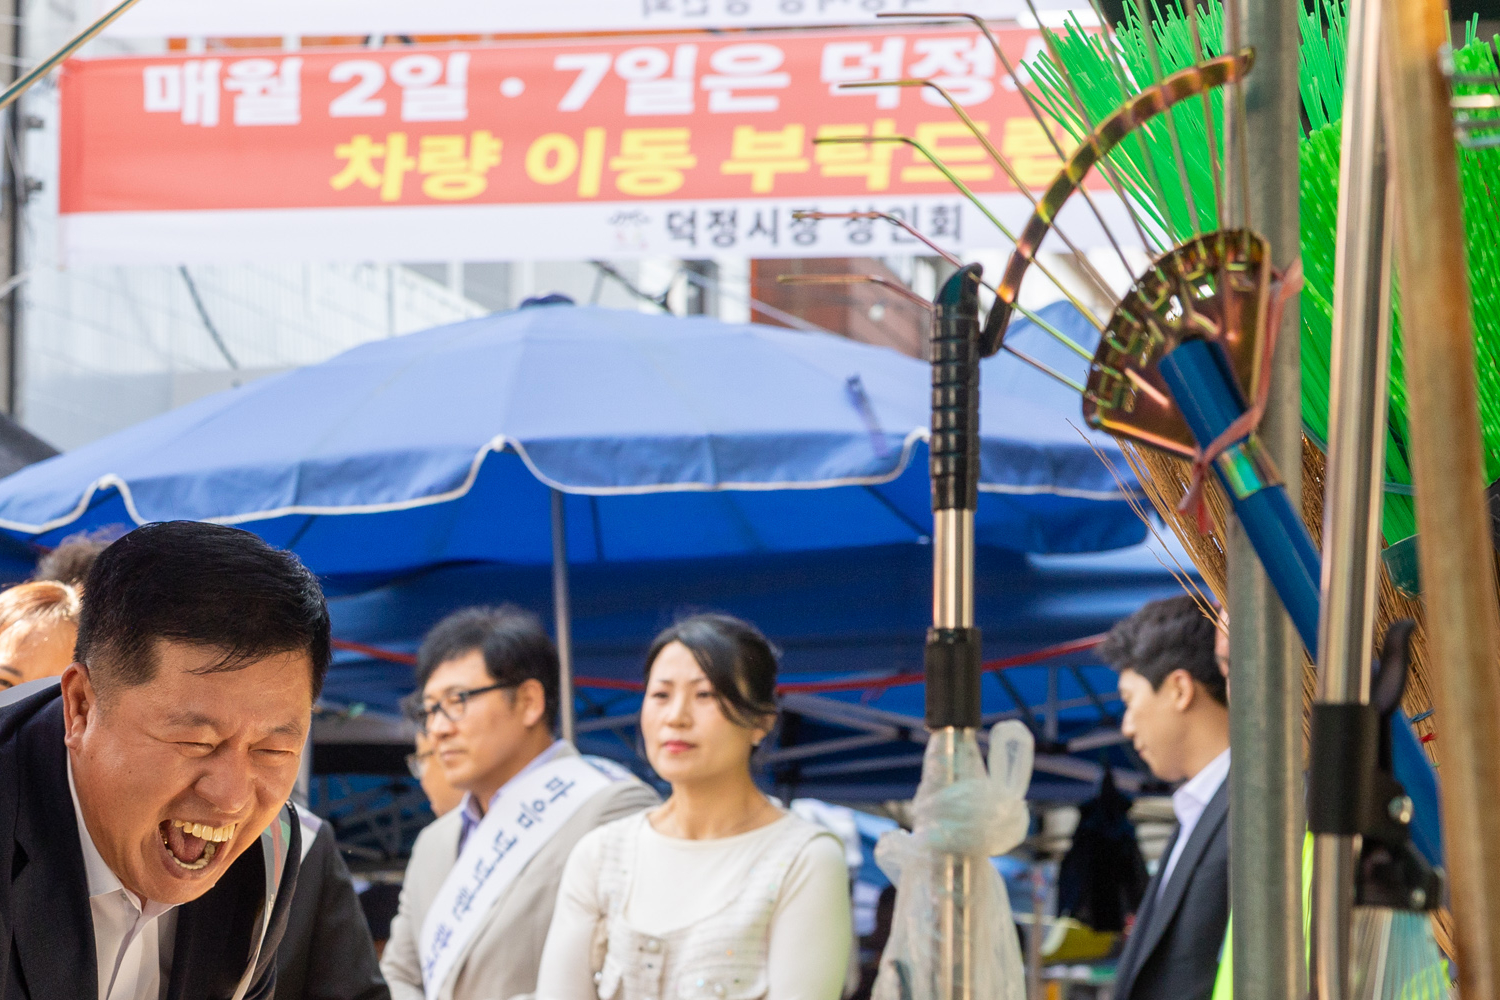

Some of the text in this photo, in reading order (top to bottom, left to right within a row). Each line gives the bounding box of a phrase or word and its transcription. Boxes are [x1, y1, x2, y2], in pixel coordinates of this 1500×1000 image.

[143, 56, 303, 127] 매월
[328, 52, 471, 122] 2일
[554, 43, 791, 115] 7일은
[329, 129, 503, 201] 차량
[525, 126, 698, 198] 이동
[665, 203, 964, 247] 덕정시장 상인회
